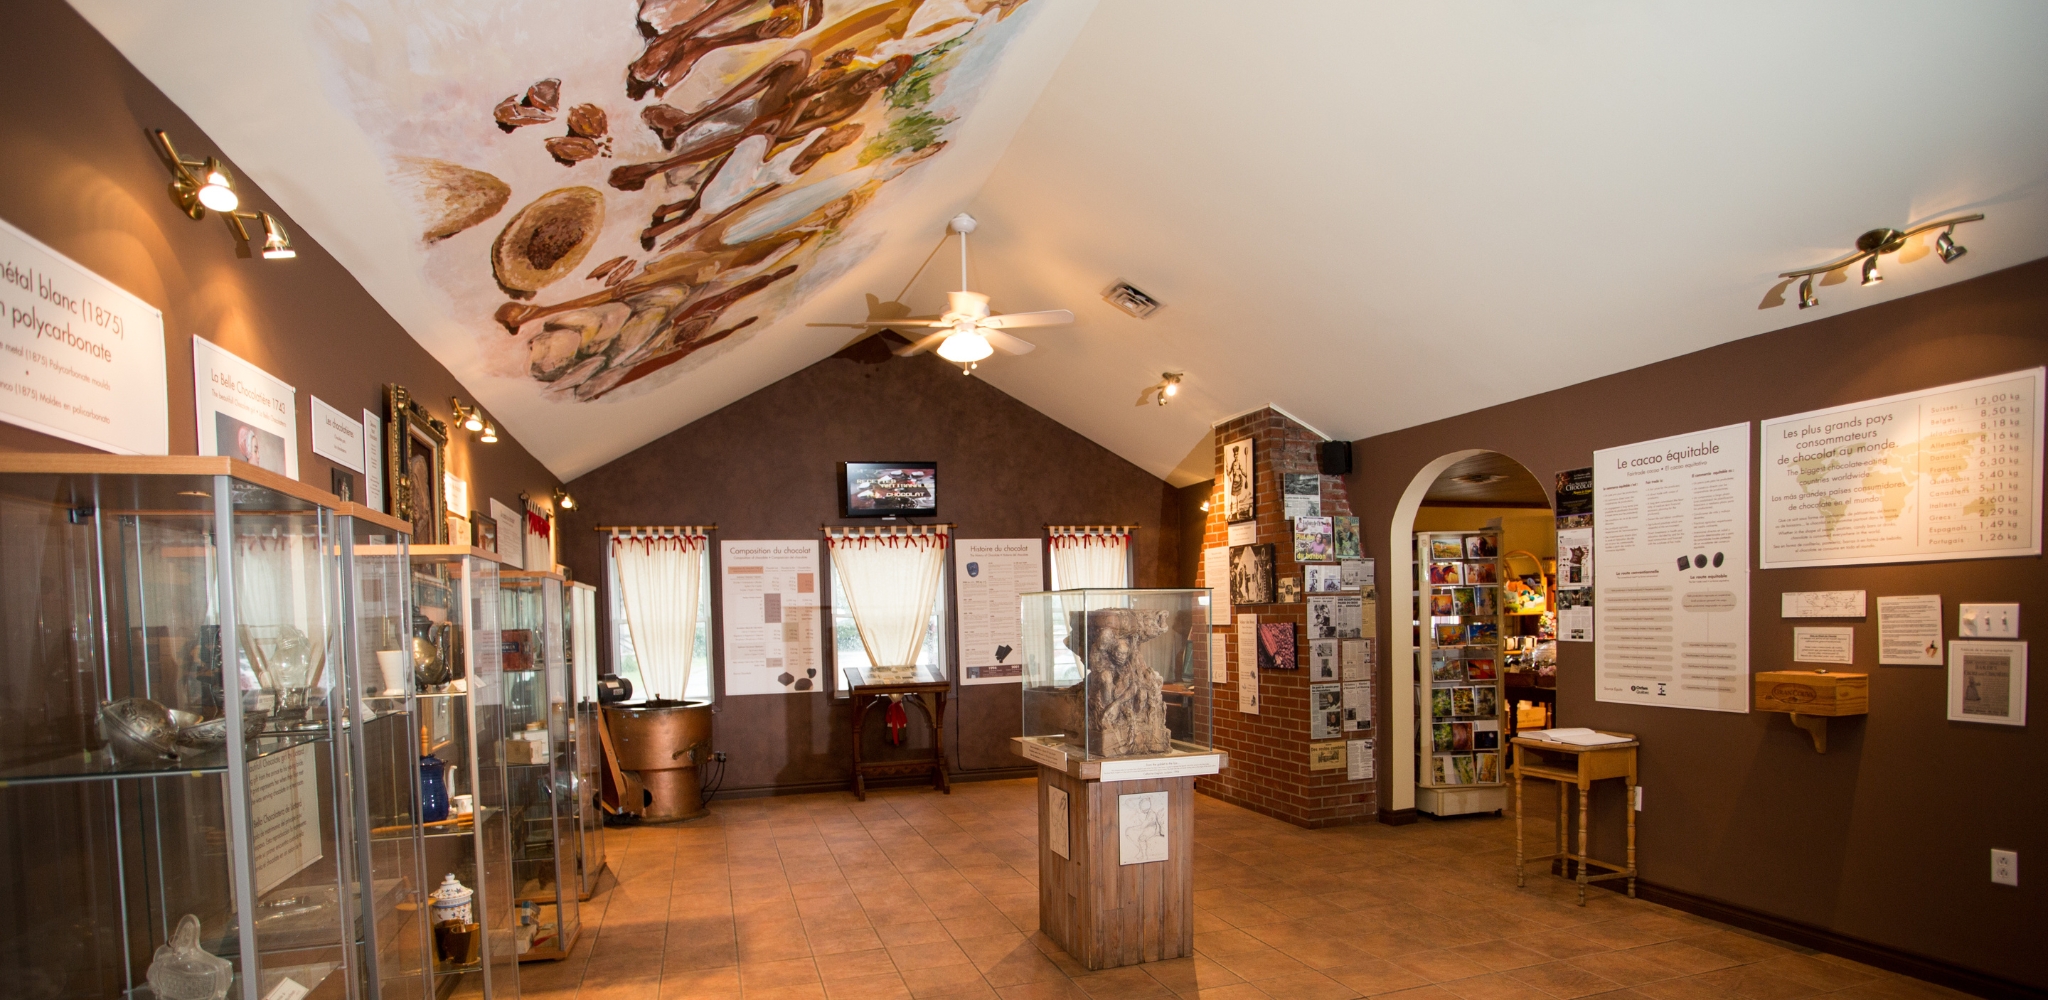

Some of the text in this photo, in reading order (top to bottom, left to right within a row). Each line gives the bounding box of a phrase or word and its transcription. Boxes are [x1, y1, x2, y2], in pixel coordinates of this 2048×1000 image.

[39, 273, 77, 314] blanc
[82, 298, 124, 340] (1875)
[12, 305, 112, 363] polycarbonate
[5, 344, 24, 357] metal
[25, 348, 48, 368] (1875)
[49, 358, 91, 383] Polycarbonate
[91, 377, 111, 391] moulds
[211, 368, 286, 415] La Belle Chocolatière 1743
[15, 383, 38, 402] (1875)
[39, 393, 62, 408] Moldes
[63, 402, 71, 410] en
[72, 404, 111, 424] policarbonato
[1931, 393, 2020, 413] Suisses 12,00 kg
[1930, 406, 2020, 426] Belges 8,50 kg
[1980, 418, 2006, 430] 8,18
[2009, 418, 2020, 427] kg
[1783, 413, 1893, 439] Les plus grands pays
[1796, 429, 1878, 450] consommateurs
[1930, 431, 2019, 449] Allemands 8,16 kg
[1617, 440, 1720, 470] Le cacao équitable
[1777, 438, 1899, 465] de chocolat au monde.
[1930, 444, 2019, 462] Danois 8,12 kg
[1626, 469, 1646, 477] Fairtrade
[1684, 460, 1708, 469] equitativo
[1787, 457, 1888, 477] The biggest chocolate-eating
[1929, 456, 2019, 474] Français 6,30 kg
[1799, 476, 1829, 486] countries
[1929, 469, 2019, 485] Québécois 5,40 kg
[1783, 493, 1797, 501] más
[1798, 489, 1827, 502] grandes
[1828, 487, 1852, 498] países
[1853, 480, 1906, 493] consumidores
[1929, 482, 2018, 497] Canadiens 5,11 kg
[1788, 503, 1797, 511] de
[1798, 500, 1832, 511] chocolate
[1844, 497, 1852, 505] el
[1929, 494, 2018, 510] Italiens 2,60 kg
[1979, 507, 2004, 518] 2,29
[2008, 508, 2018, 516] kg
[1928, 520, 2018, 534] Espagnols 1,49 kg
[994, 544, 1002, 552] du
[1003, 544, 1028, 552] chocolat
[1928, 533, 2018, 546] Portugais 1,26 kg
[729, 546, 811, 555] Composition du chocolat
[262, 754, 280, 768] Chocolate
